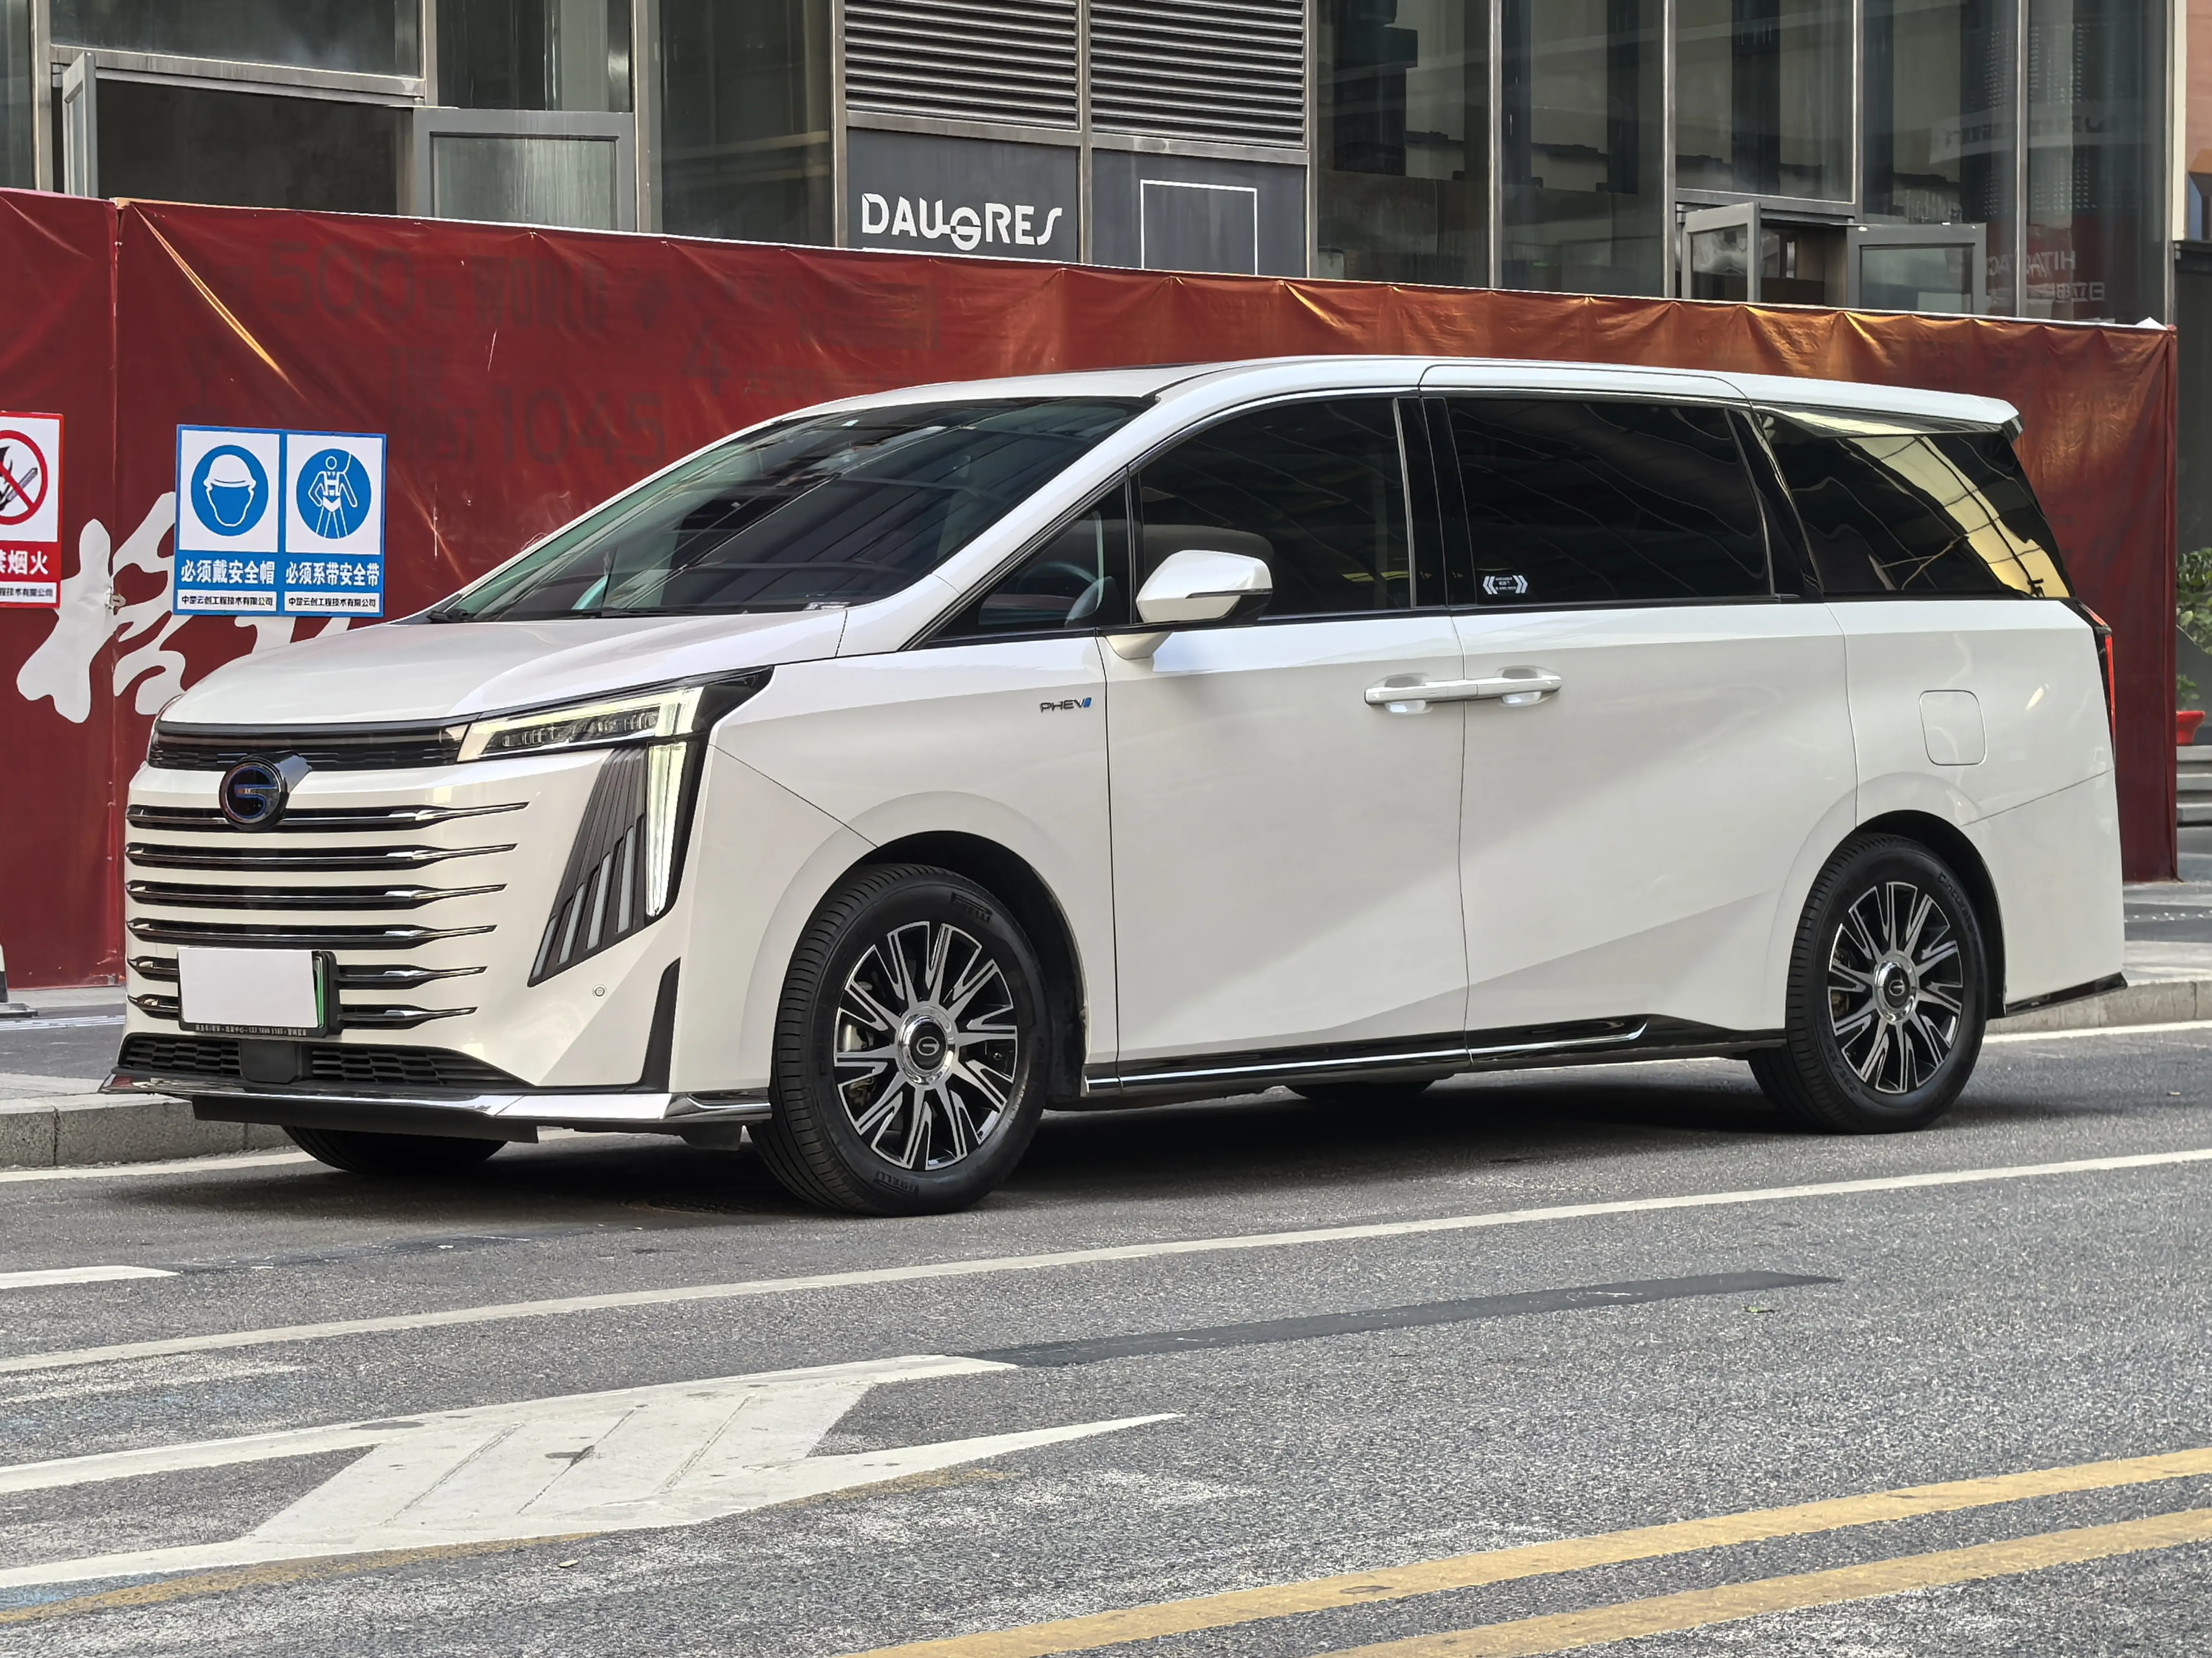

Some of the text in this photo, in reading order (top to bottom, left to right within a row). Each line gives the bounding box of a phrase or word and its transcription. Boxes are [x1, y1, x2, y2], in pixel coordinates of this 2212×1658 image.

[181, 559, 275, 584] 必须戴安全帽
[286, 561, 380, 586] 必须系带安全带
[1039, 697, 1085, 713] PHEV
